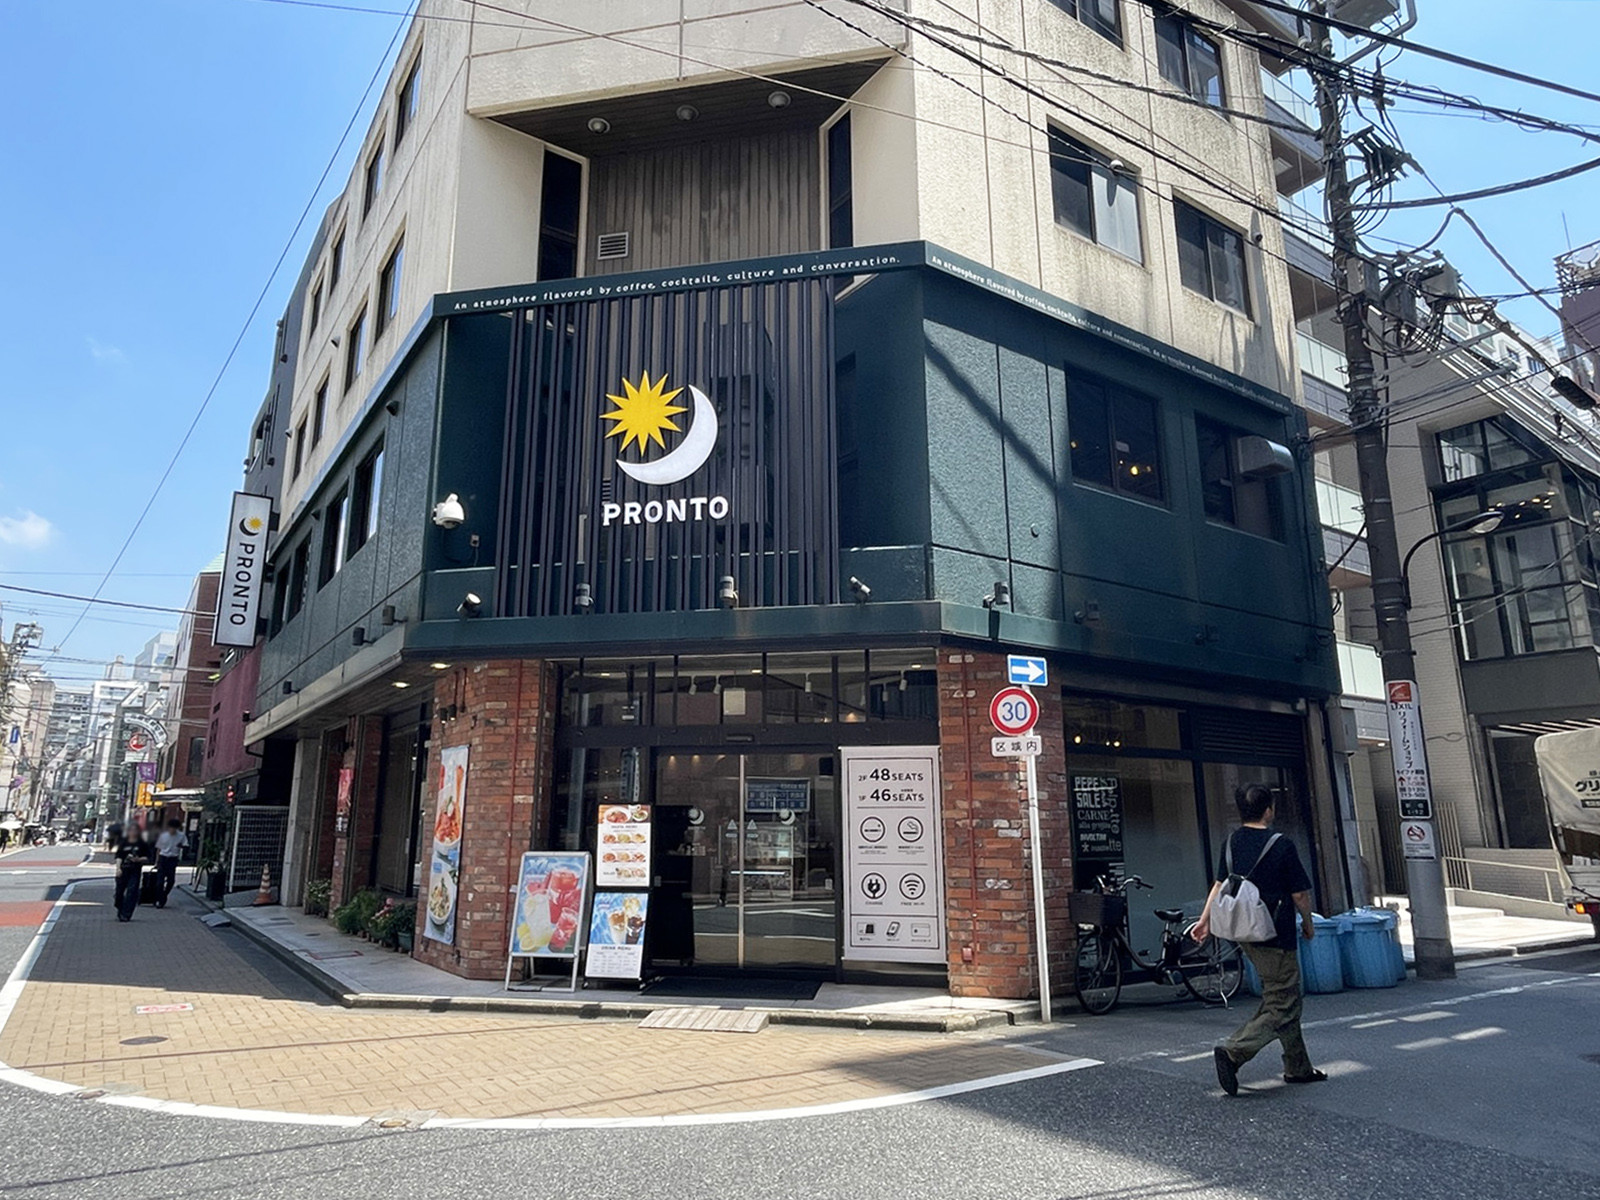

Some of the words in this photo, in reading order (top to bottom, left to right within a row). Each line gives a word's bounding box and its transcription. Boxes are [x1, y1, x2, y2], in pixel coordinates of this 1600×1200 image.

[931, 255, 942, 266] An
[454, 302, 467, 310] An
[473, 295, 537, 308] atmosphere
[543, 287, 592, 300] flavored
[599, 286, 612, 295] by
[616, 282, 656, 293] coffee,
[661, 275, 721, 287] cocktails,
[727, 269, 775, 280] culture
[782, 265, 804, 275] and
[811, 256, 900, 272] conversation.
[602, 495, 729, 526] PRONTO
[229, 542, 256, 626] PRONTO
[1002, 701, 1028, 722] 30
[995, 741, 1037, 753] 区域内
[869, 768, 891, 781] 48
[891, 773, 924, 781] SEATS
[870, 788, 891, 802] 46
[892, 793, 925, 802] SEATS
[1076, 792, 1101, 808] SALE
[1077, 809, 1109, 820] CARNE
